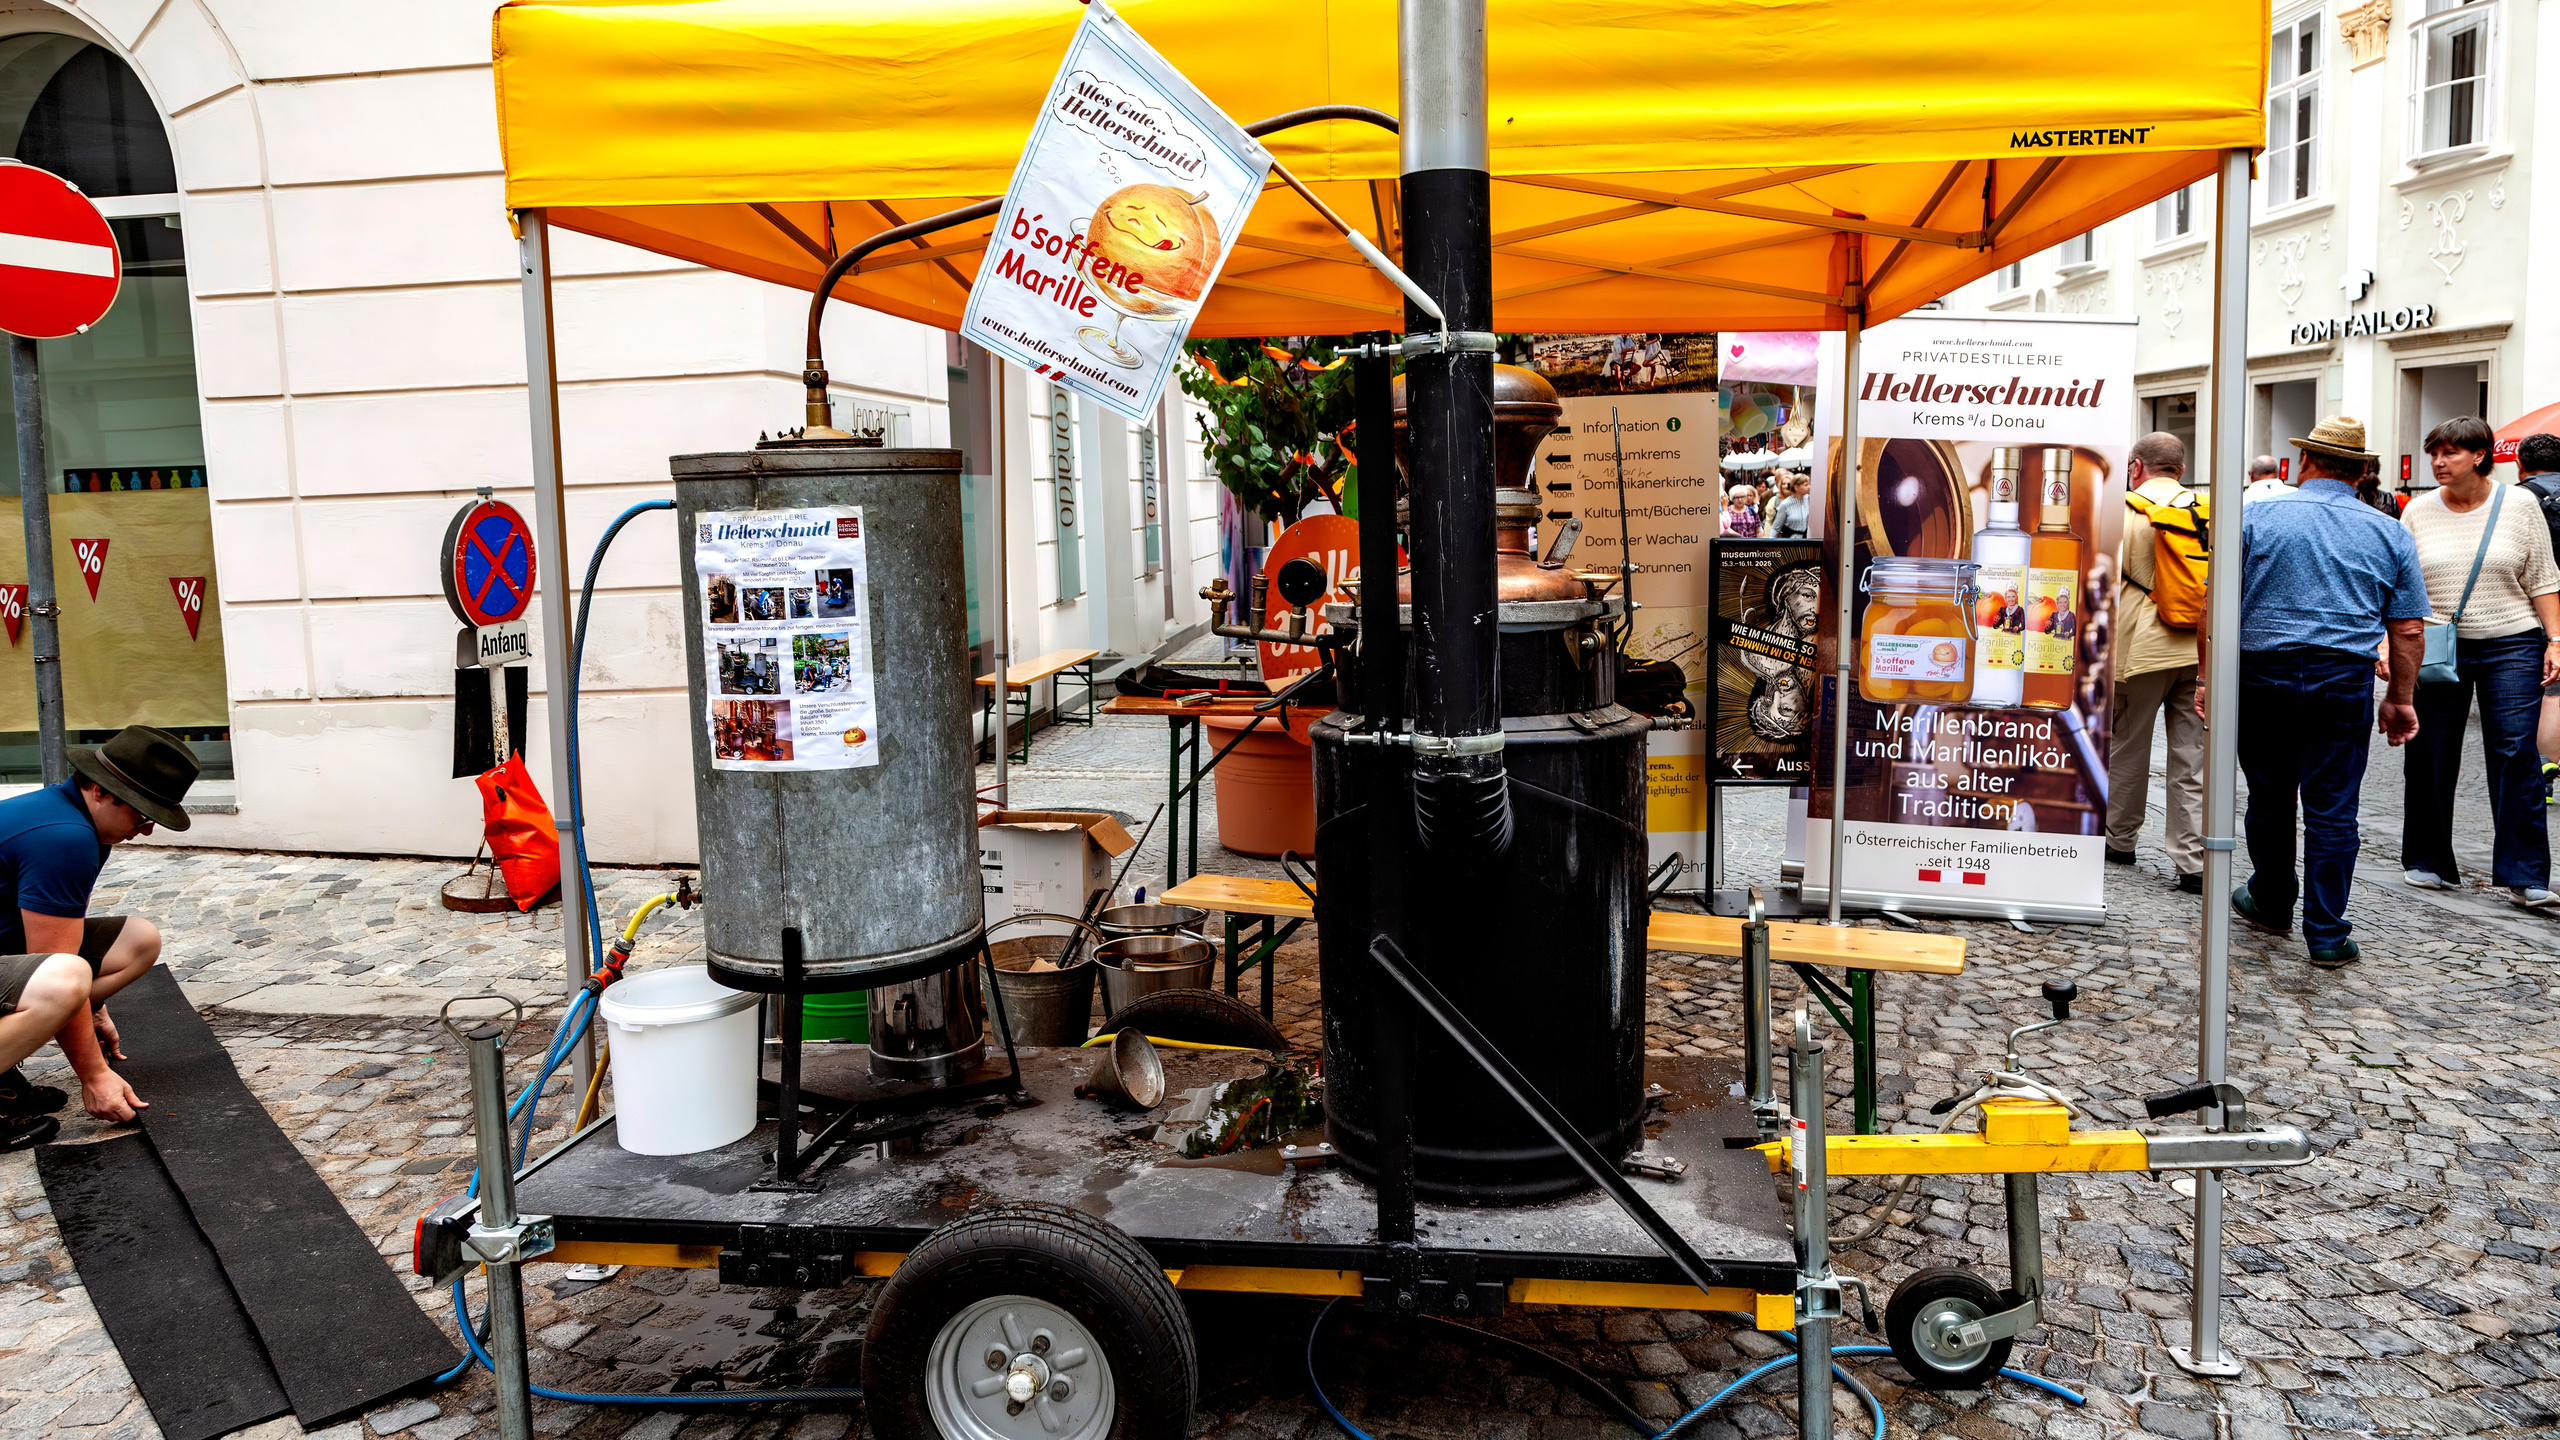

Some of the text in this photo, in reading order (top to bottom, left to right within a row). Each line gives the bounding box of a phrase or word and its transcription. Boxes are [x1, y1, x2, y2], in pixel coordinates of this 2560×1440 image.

[1071, 81, 1166, 135] Alles Gute...
[1060, 95, 1202, 173] Hellerschmid
[995, 248, 1097, 317] Marille
[2334, 303, 2433, 338] TAILOR
[1932, 338, 2033, 348] www.hellerschmid.com
[981, 315, 1139, 398] www.hellerschmid.com
[1902, 350, 2064, 366] PRIVATDESTILLERIE
[1858, 372, 2105, 408] Hellerschmid
[1583, 420, 1660, 433] Information
[1912, 411, 1964, 426] Krems
[1991, 413, 2045, 428] Donau
[1552, 434, 1574, 442] 100m
[1583, 449, 1681, 462] museumkrems
[1584, 476, 1705, 490] Dominikanerkirche
[1553, 491, 1575, 499] 100m
[718, 520, 831, 540] Hellerschmid
[776, 540, 803, 548] Donau
[1585, 535, 1616, 547] Dom
[1645, 532, 1698, 545] Wachau
[1721, 550, 1781, 558] museumkrems
[481, 631, 526, 658] Anfang
[1731, 623, 1815, 655] WIE IM HIMMEL, SO
[2027, 642, 2067, 653] Marillen
[1876, 709, 2052, 740] Marillenbrand
[1855, 737, 2071, 769] und Marillenlikör
[1647, 762, 1675, 770] rems.
[1660, 772, 1683, 782] Stadt
[1685, 772, 1700, 781] der
[1906, 768, 2015, 794] aus alter
[1897, 792, 2018, 822] Tradition!
[1856, 830, 1966, 851] Österreichischer
[1970, 840, 2078, 859] Familienbetrieb
[1956, 857, 1991, 871] 1948
